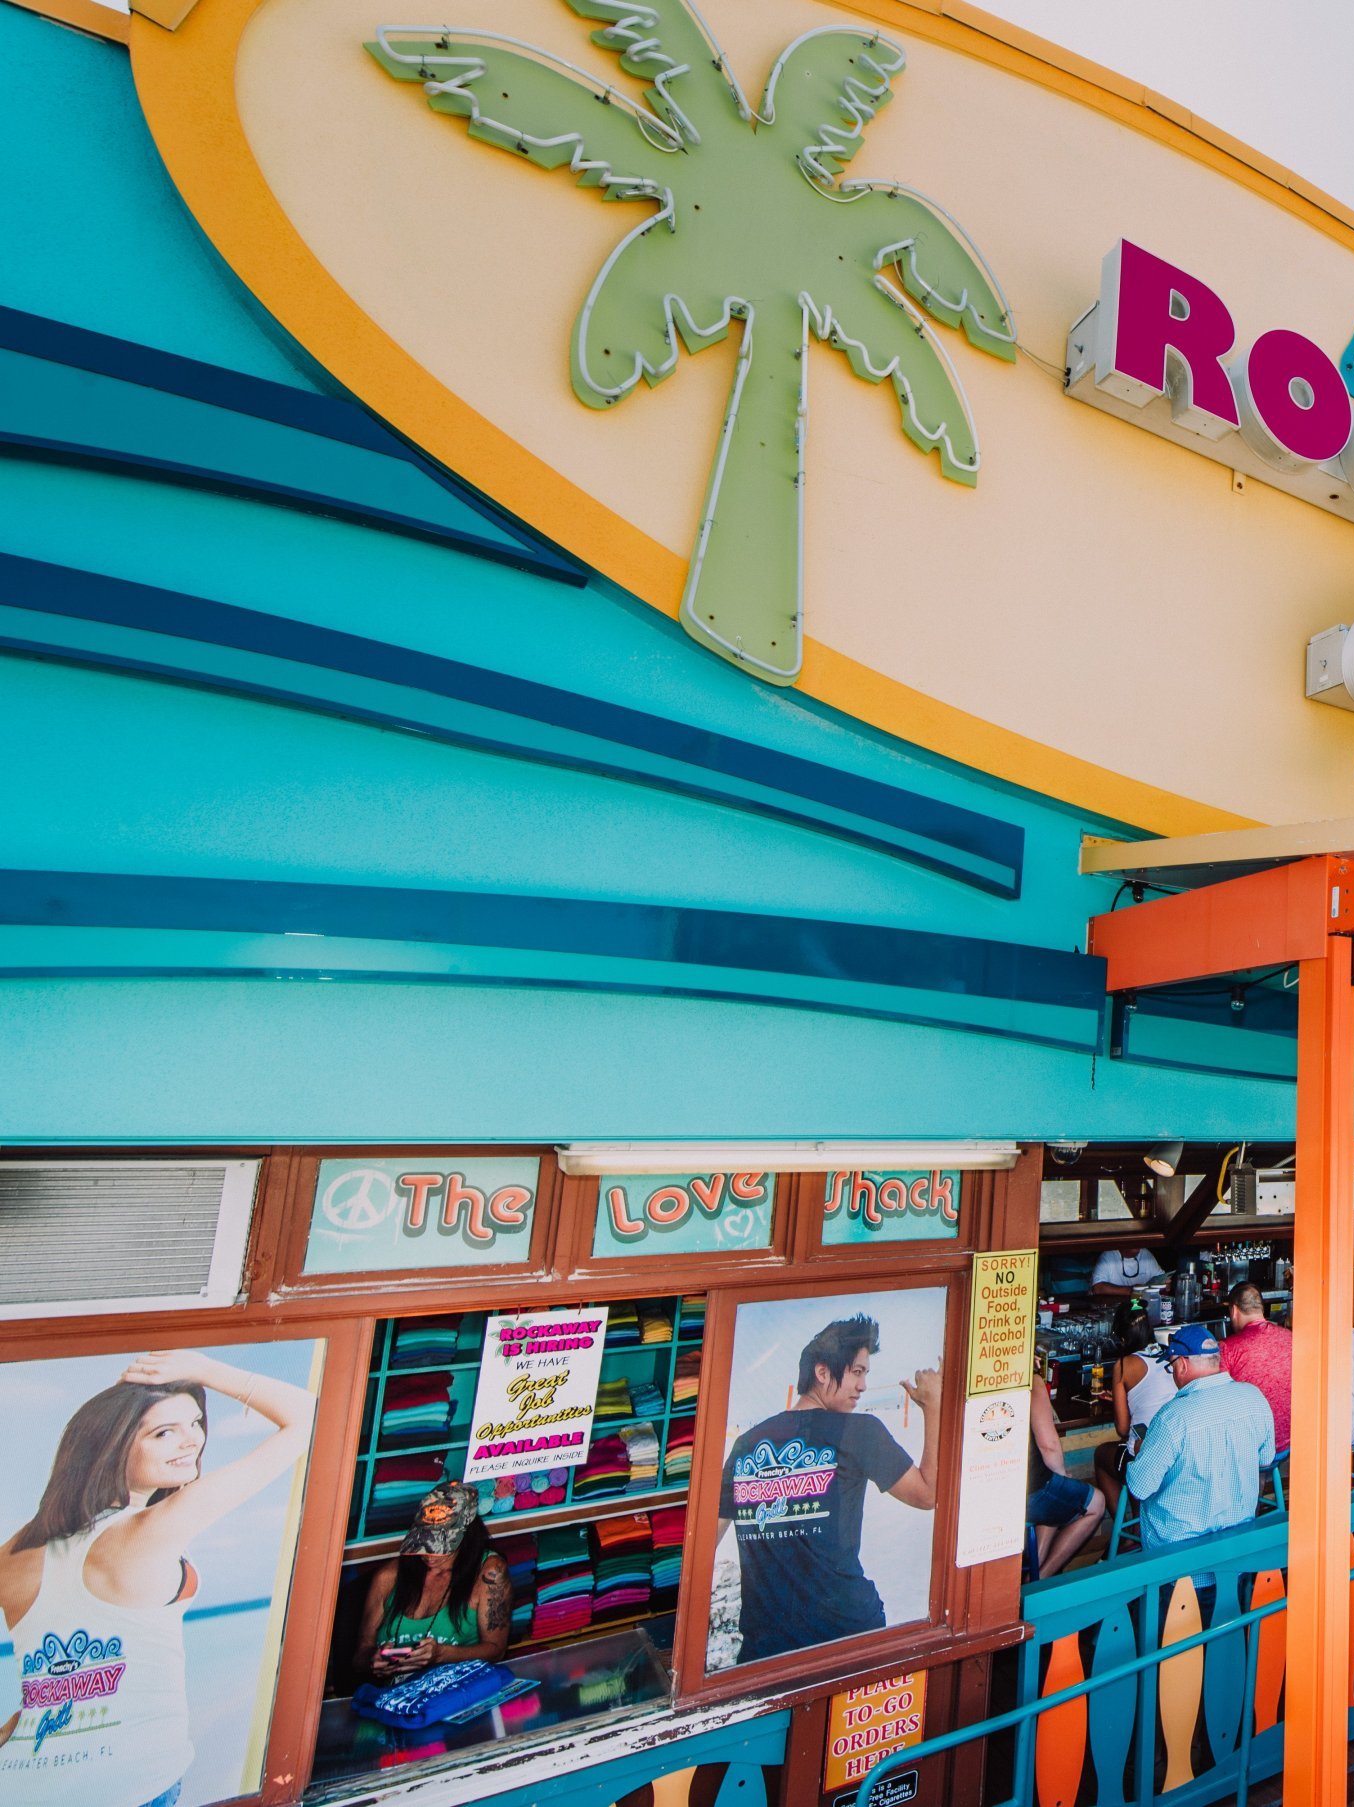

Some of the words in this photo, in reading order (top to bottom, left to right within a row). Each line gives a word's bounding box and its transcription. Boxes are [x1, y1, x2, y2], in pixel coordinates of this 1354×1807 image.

[398, 1173, 533, 1245] The
[608, 1172, 767, 1237] Love
[981, 1256, 1031, 1272] SORRY!
[995, 1270, 1015, 1285] NO
[981, 1284, 1028, 1300] Outside
[987, 1299, 1021, 1314] Food,
[499, 1319, 603, 1342] ROCKAWAY
[978, 1315, 1011, 1330] Drink
[1014, 1313, 1027, 1326] or
[979, 1326, 1026, 1345] Alcohol
[502, 1343, 522, 1358] IS
[525, 1336, 595, 1355] HIRING
[978, 1343, 1025, 1360] Allowed
[516, 1359, 534, 1370] WE
[537, 1356, 570, 1368] HAVE
[992, 1359, 1009, 1373] On
[506, 1369, 570, 1402] Great
[975, 1369, 1025, 1389] Property
[516, 1388, 555, 1420] Job
[475, 1404, 593, 1441] Opportunities
[473, 1431, 585, 1461] AVAILABLE
[469, 1462, 509, 1475] PLEASE
[512, 1455, 550, 1468] INQUIRE
[553, 1450, 584, 1462] INSIDE
[757, 1466, 791, 1478] Frenchy's
[737, 1531, 775, 1542] CLEARWATER
[812, 1526, 822, 1534] FL
[49, 1660, 80, 1674] Frenchy's
[846, 1673, 915, 1703] PLACE
[843, 1692, 913, 1728] TO-GO
[832, 1713, 921, 1758] ORDERS
[1, 1756, 48, 1771] EARWATER
[100, 1745, 113, 1756] FL
[879, 1789, 913, 1807] Cigarettes
[886, 1783, 911, 1797] Facility
